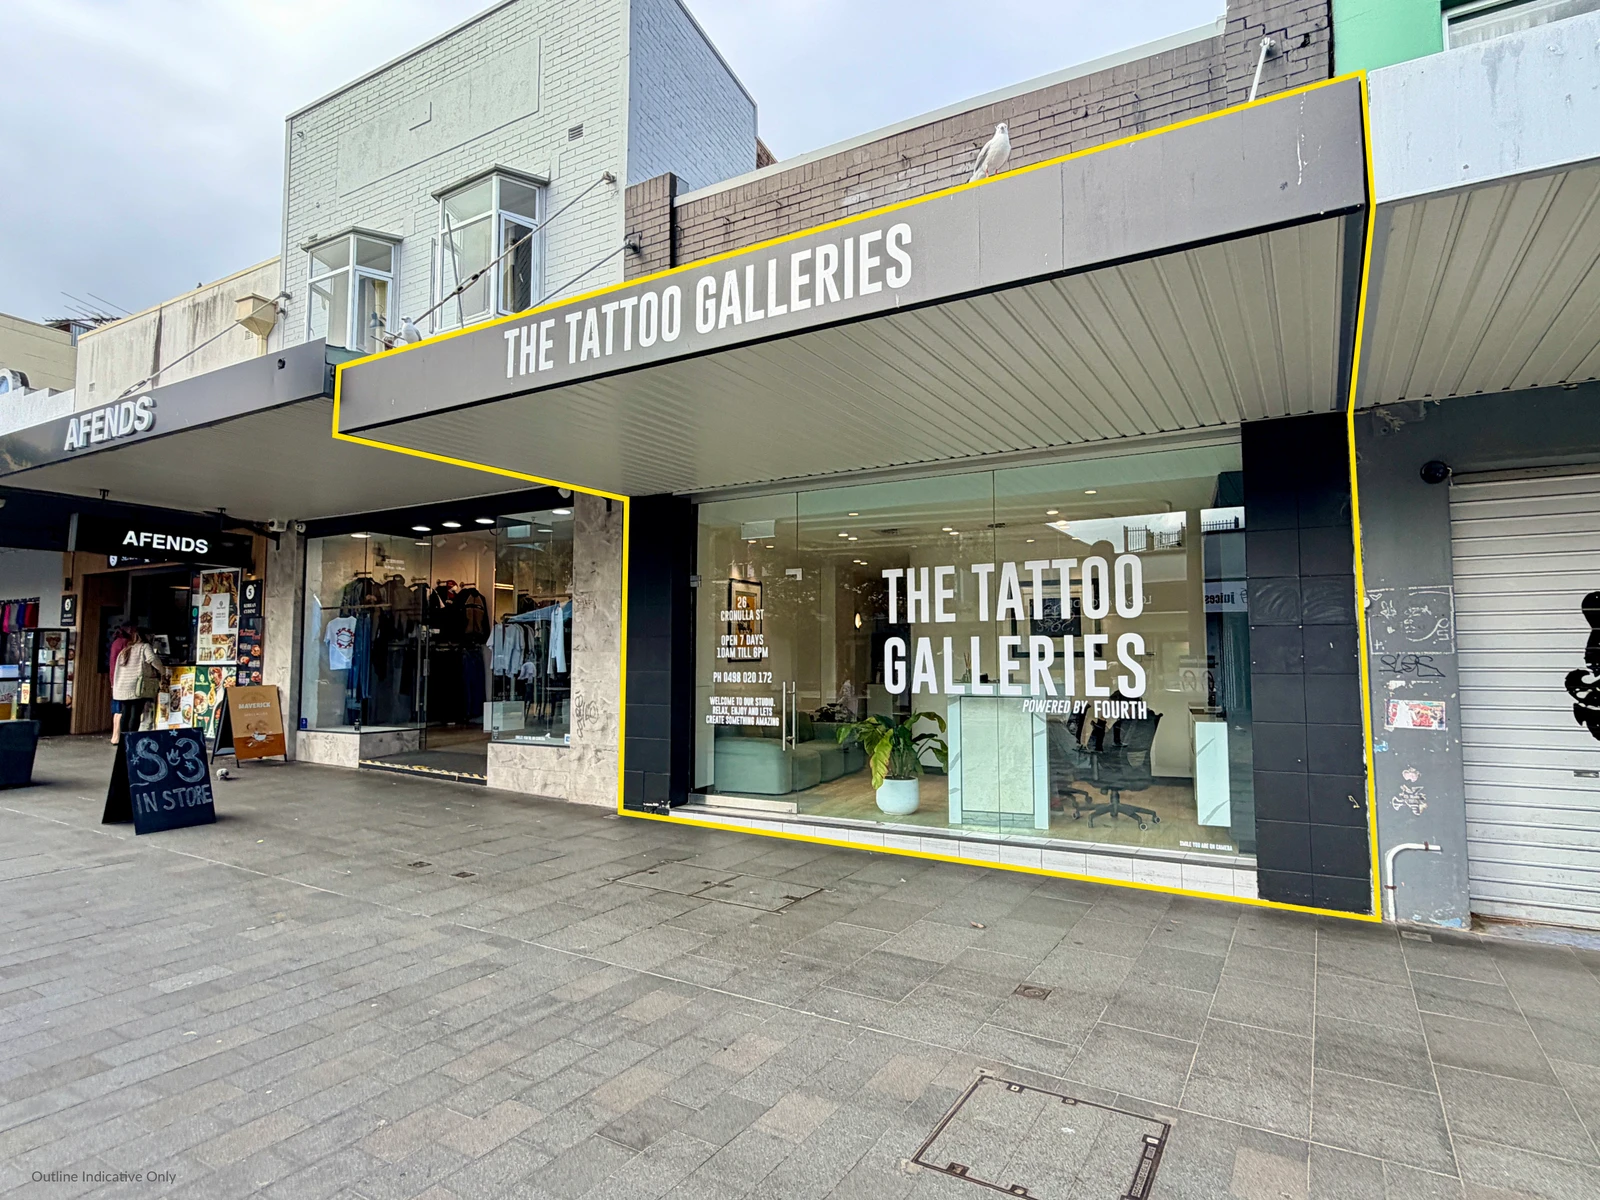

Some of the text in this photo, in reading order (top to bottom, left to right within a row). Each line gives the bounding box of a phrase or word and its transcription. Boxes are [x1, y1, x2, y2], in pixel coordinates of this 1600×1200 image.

[503, 222, 912, 378] THE TATTOO GALLERIES
[64, 396, 154, 451] AFENDS
[122, 530, 209, 554] AFENDS
[882, 565, 956, 624] THE
[971, 554, 1145, 622] TATTOO
[737, 596, 747, 608] 26
[720, 609, 764, 621] CRONULLA ST
[721, 634, 764, 646] OPEN 7 DAYS
[716, 647, 768, 658] 10AM TILL 6PM
[884, 632, 1147, 698] GALLERIES
[713, 672, 772, 683] PH 0498 020 172
[709, 696, 735, 705] WELCOME
[736, 697, 742, 705] TO
[744, 697, 754, 706] OUR
[731, 706, 747, 715] ENJOY
[748, 707, 759, 716] AND
[760, 707, 773, 716] LETS
[1022, 700, 1147, 719] POWERED BY FOURTH
[706, 715, 780, 726] CREATE SOMETHING AMAZING
[135, 784, 213, 814] IN STORE
